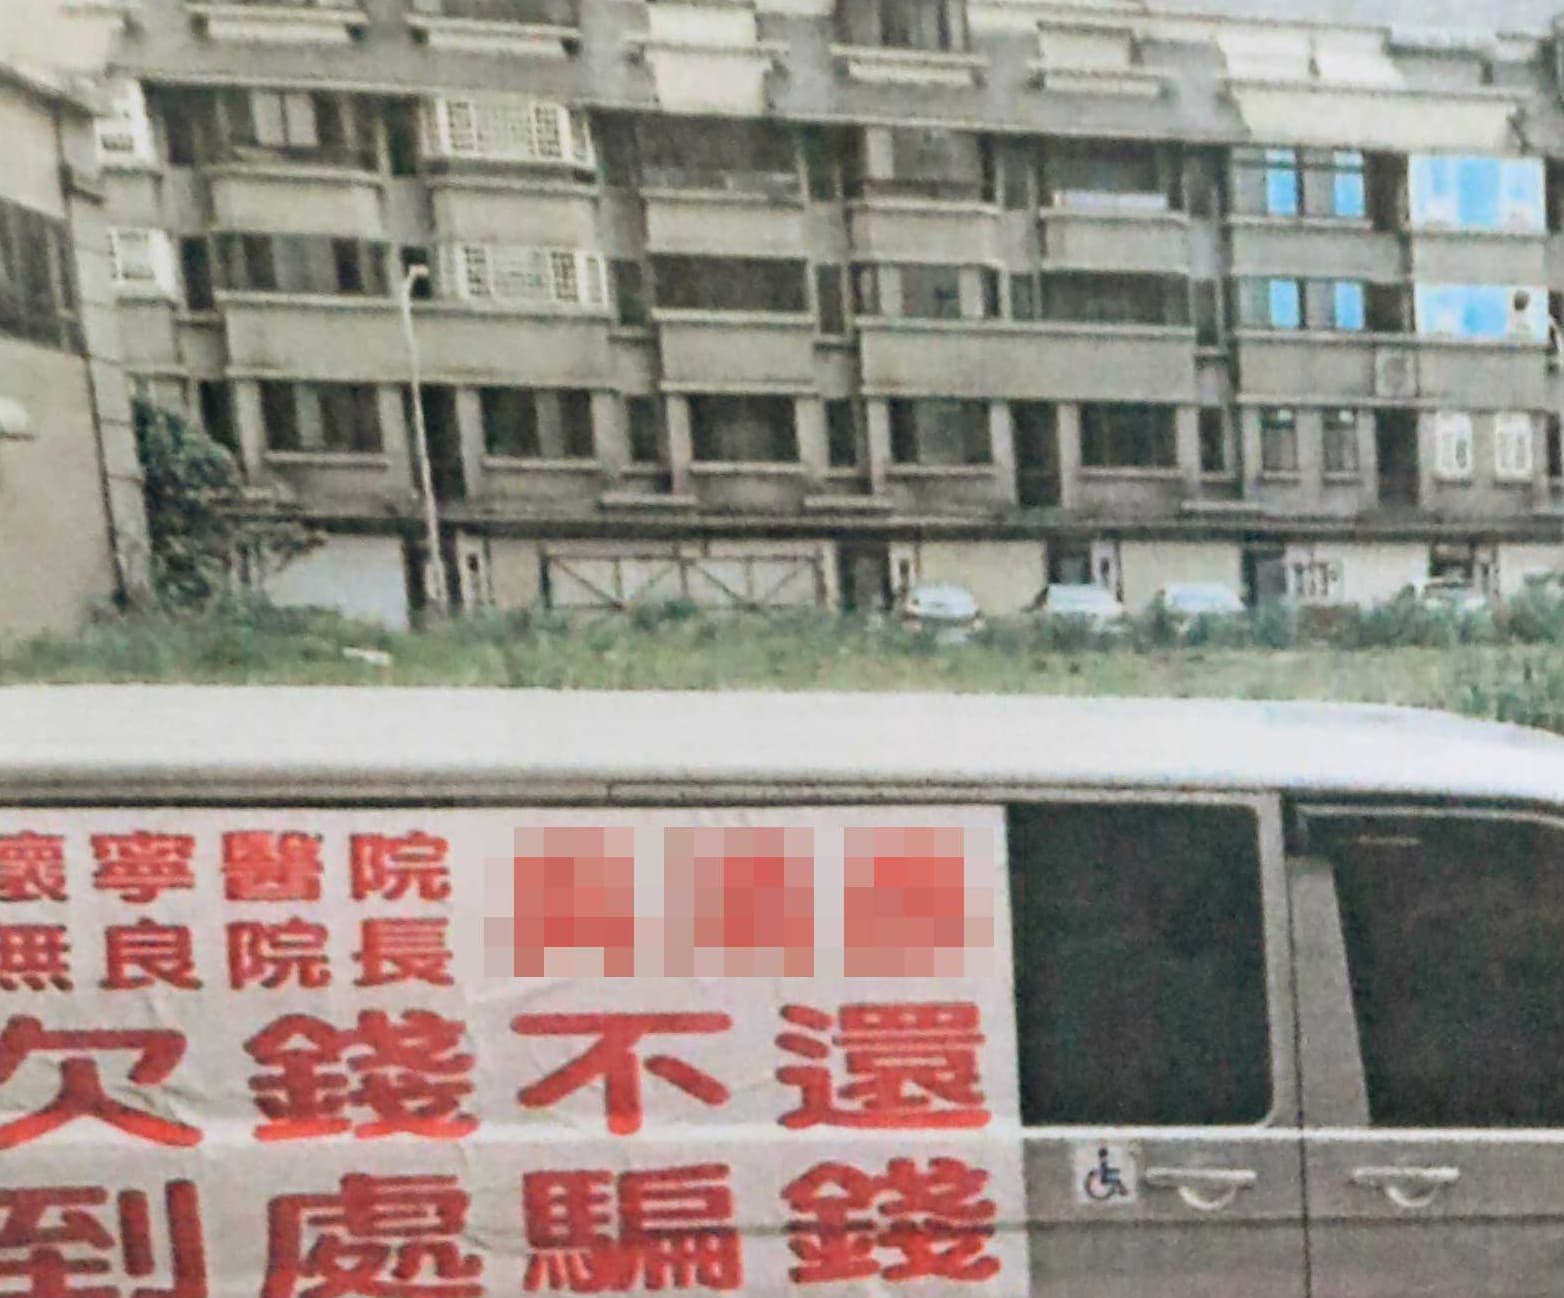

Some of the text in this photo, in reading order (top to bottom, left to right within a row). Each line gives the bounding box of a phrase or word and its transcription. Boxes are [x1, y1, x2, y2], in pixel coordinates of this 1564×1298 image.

[0, 917, 454, 991] 無良院長
[0, 1002, 992, 1148] 欠錢不還
